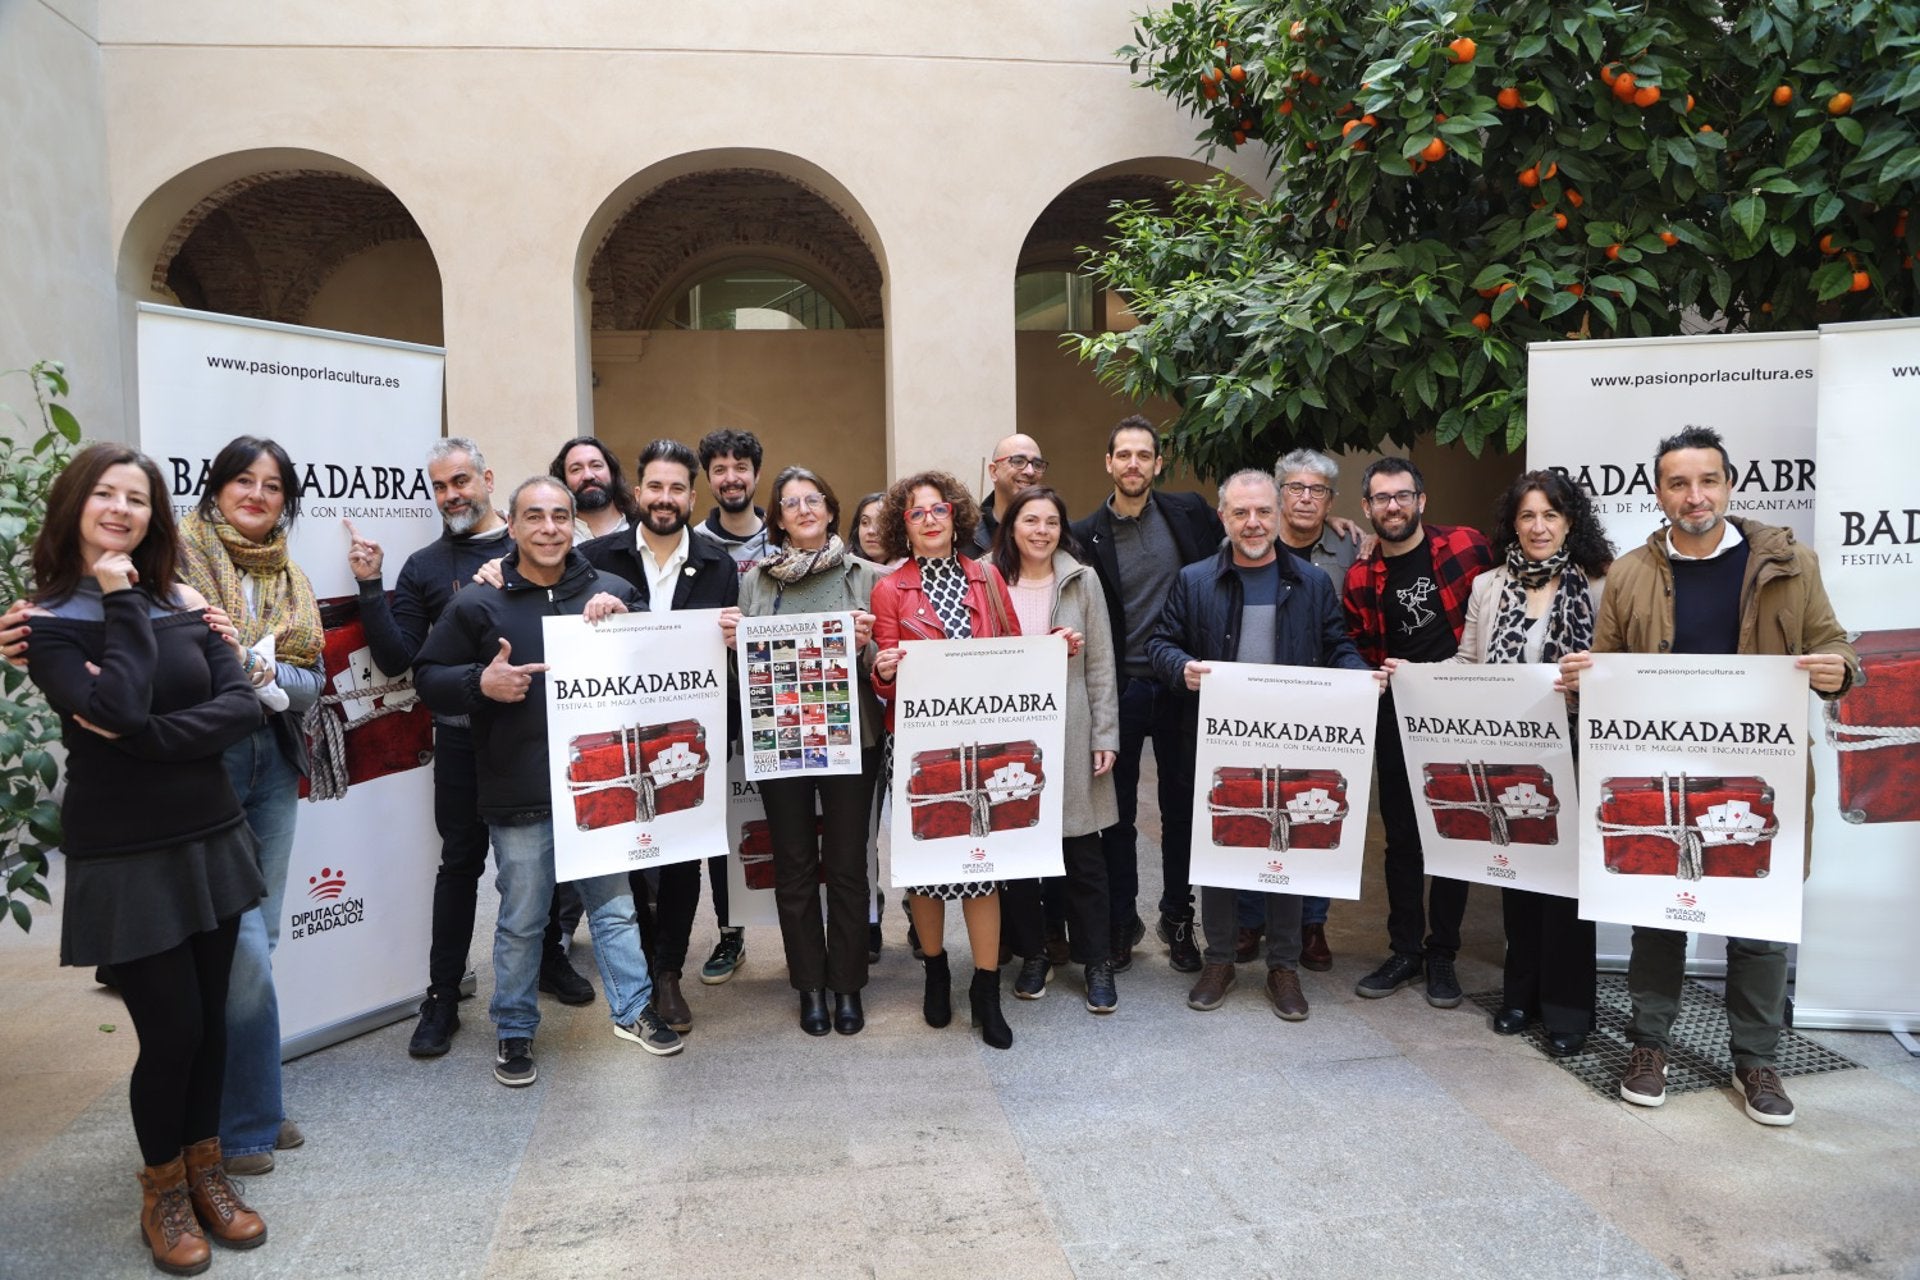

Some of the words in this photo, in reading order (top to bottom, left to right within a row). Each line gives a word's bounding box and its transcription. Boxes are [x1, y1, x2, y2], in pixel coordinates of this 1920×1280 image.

[207, 356, 400, 389] www.pasionporlacultura.es
[1590, 367, 1814, 388] www.pasionporlacultura.es
[168, 457, 431, 500] BAADABRA
[311, 506, 337, 518] CON
[343, 507, 433, 519] ENCANTAMIENTO
[1616, 503, 1632, 514] DE
[1841, 552, 1913, 566] FESTIVAL
[554, 669, 718, 700] BADAKADABRA
[639, 697, 656, 705] CON
[903, 693, 1057, 718] BADAKADABRA
[1205, 717, 1366, 745] BADAKADABRA
[1404, 716, 1561, 740] BADAKADABRA
[1588, 719, 1795, 745] BADAKADABRA
[1590, 743, 1631, 751] FESTIVAL
[1652, 744, 1683, 753] MAGIA
[1688, 746, 1708, 754] CON
[1712, 746, 1796, 756] ENCANTAMIENTO
[291, 897, 363, 928] DIPUTACIÓN
[292, 929, 304, 940] DE
[307, 910, 364, 936] BADAJOZ
